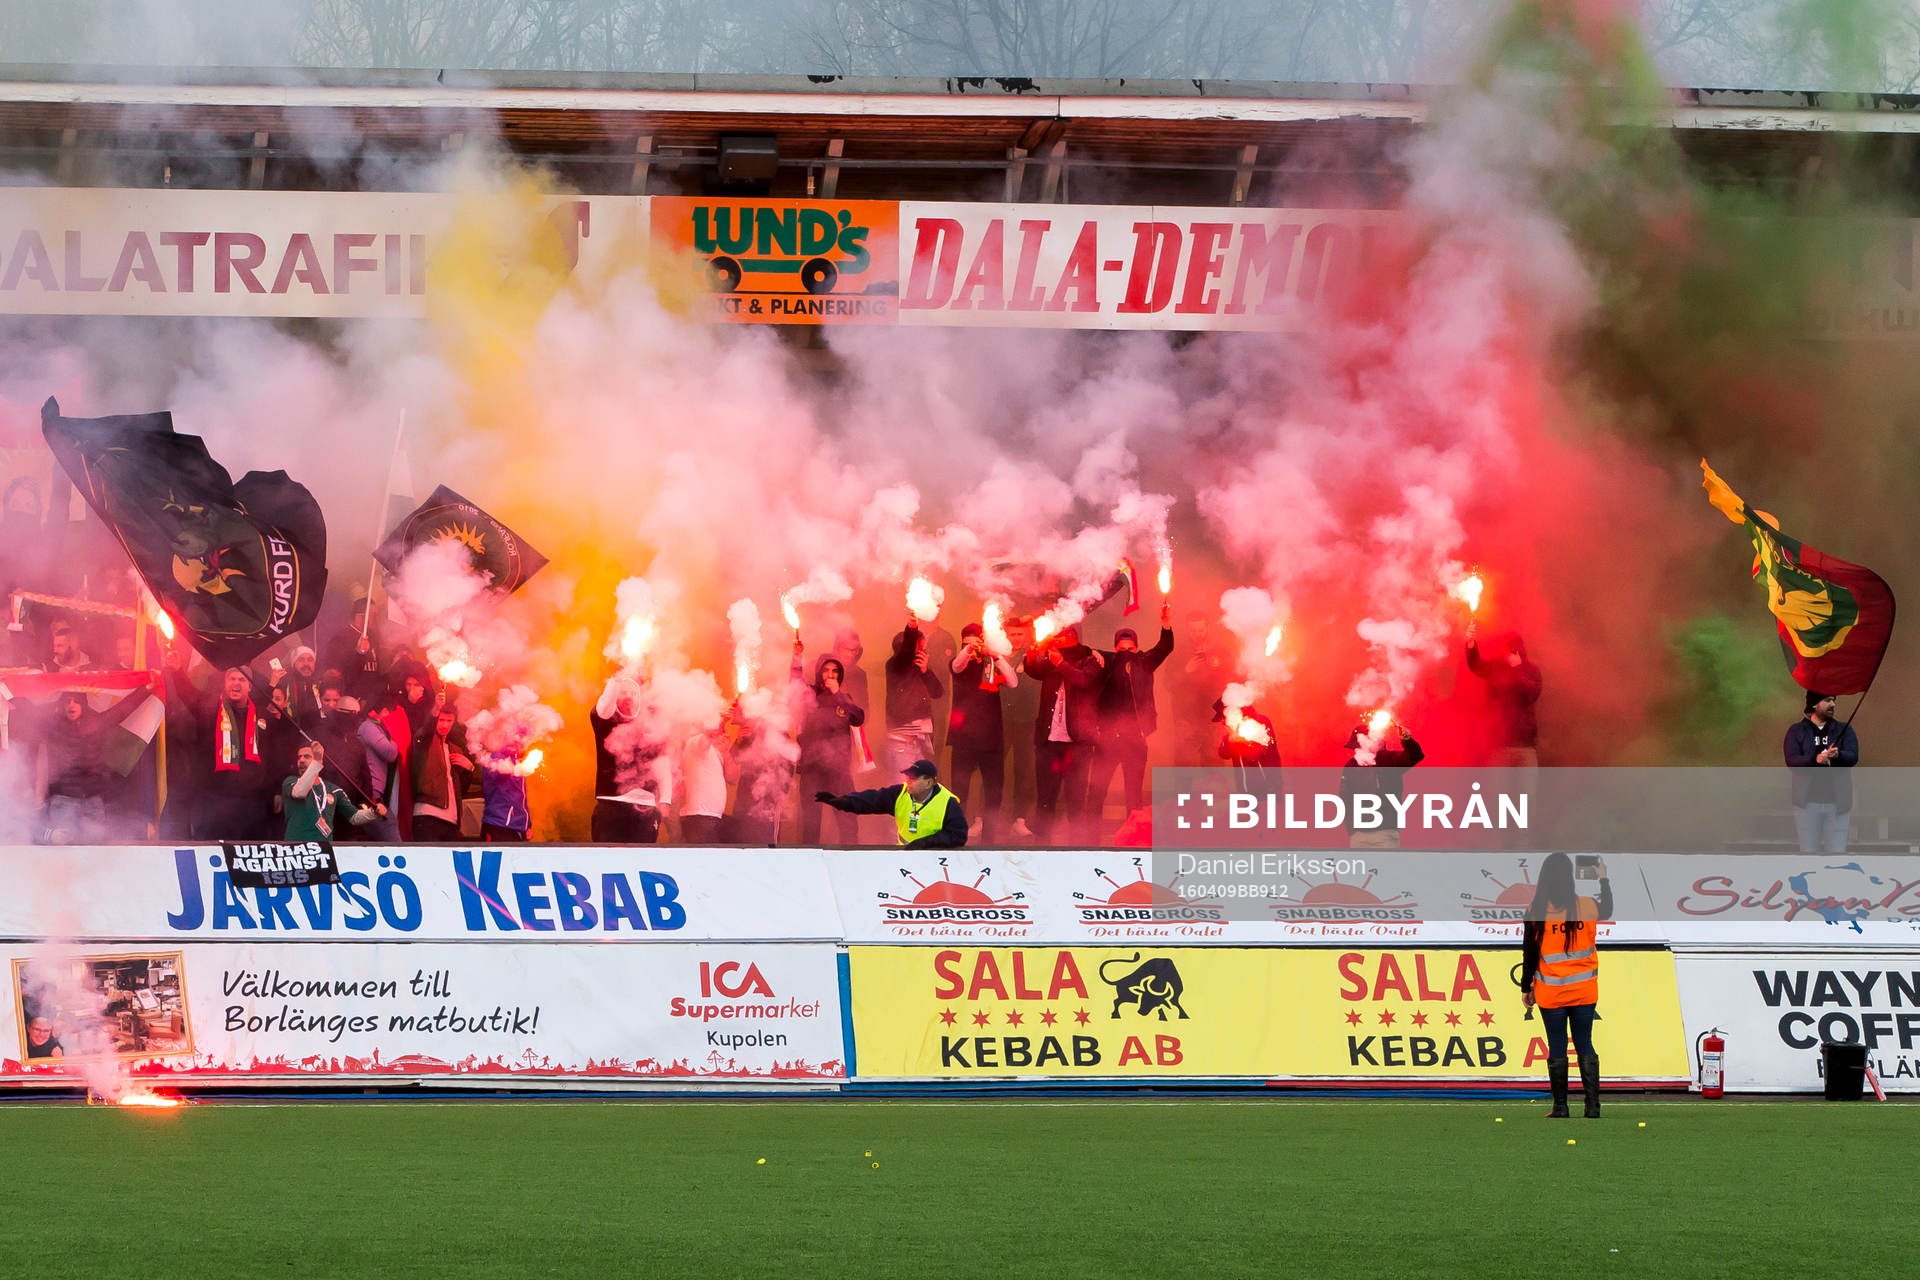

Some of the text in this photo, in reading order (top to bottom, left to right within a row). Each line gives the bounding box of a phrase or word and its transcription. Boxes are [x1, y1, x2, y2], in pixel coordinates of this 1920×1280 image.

[0, 229, 426, 295] ALATRAFI
[749, 299, 763, 315] &
[771, 299, 887, 316] PLANERING
[269, 561, 293, 634] KURD
[232, 853, 331, 873] AGAINST
[233, 841, 322, 858] ULTRAS
[261, 869, 310, 885] ISIS
[452, 850, 687, 931] KEBAB
[886, 907, 1026, 920] SNABBGROSS
[1082, 907, 1222, 920] SNABBGROSS
[1276, 907, 1416, 920] SNABBGROSS
[1551, 920, 1585, 935] FOO
[222, 968, 452, 999] Välkommen till
[699, 961, 776, 998] ICA
[934, 950, 1089, 1001] SALA
[1338, 952, 1492, 1001] SALA
[670, 996, 820, 1022] Supermarket
[224, 1004, 541, 1043] Borlänges matbutik!
[706, 1029, 788, 1050] Kupolen
[941, 1034, 1184, 1067] KEBAB AB
[1347, 1035, 1507, 1068] KEBAB
